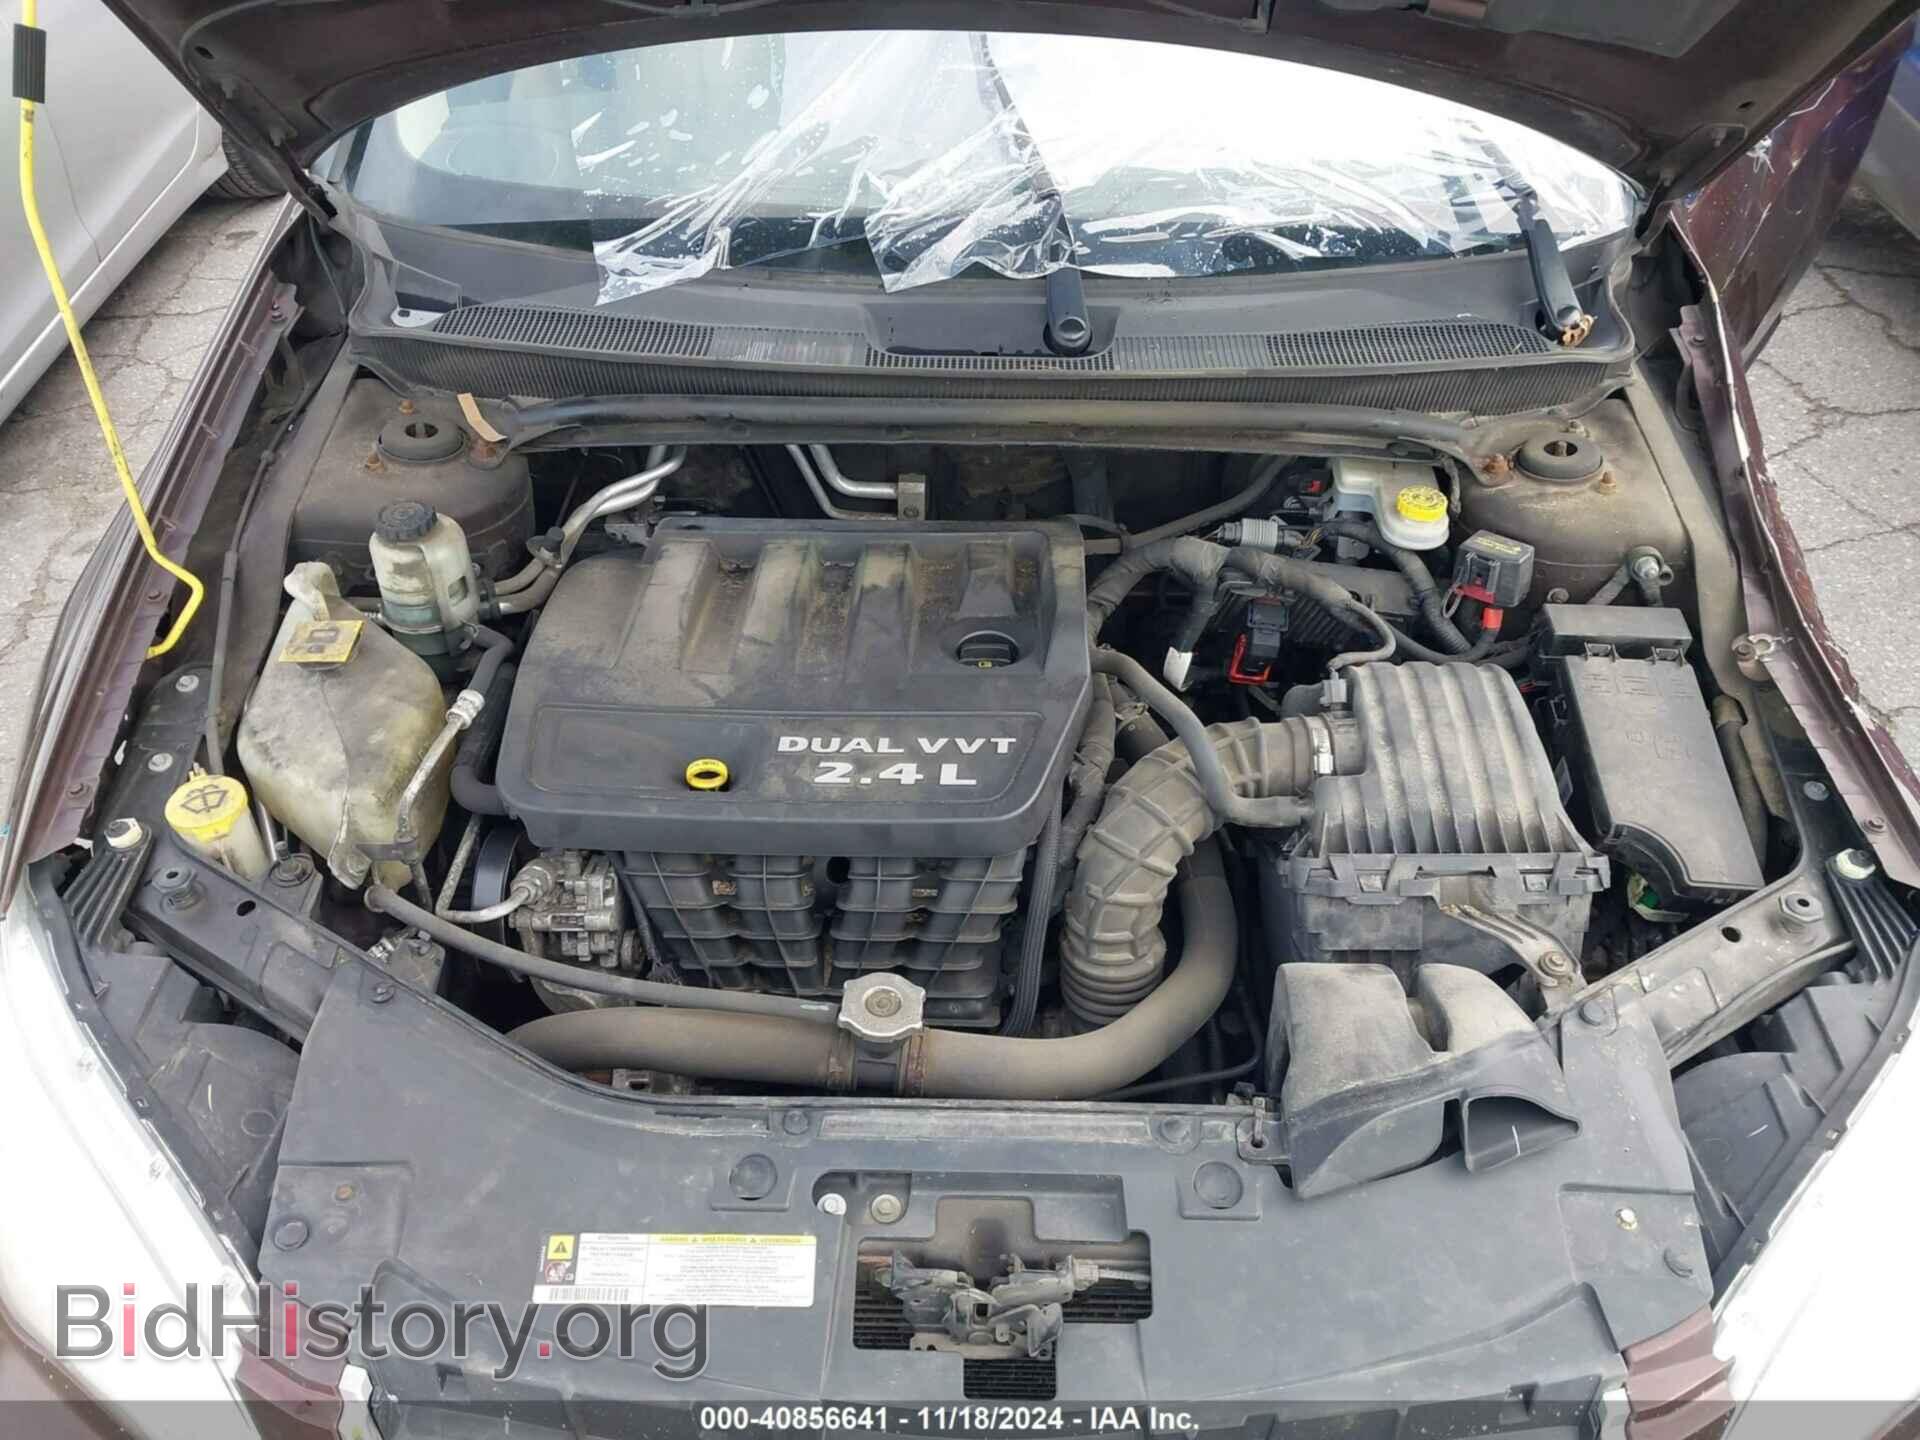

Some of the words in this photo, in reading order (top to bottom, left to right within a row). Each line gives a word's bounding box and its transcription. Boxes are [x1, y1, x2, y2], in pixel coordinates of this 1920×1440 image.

[777, 736, 905, 753] DUAL
[917, 737, 1017, 754] VVT
[813, 761, 924, 785] 2.4
